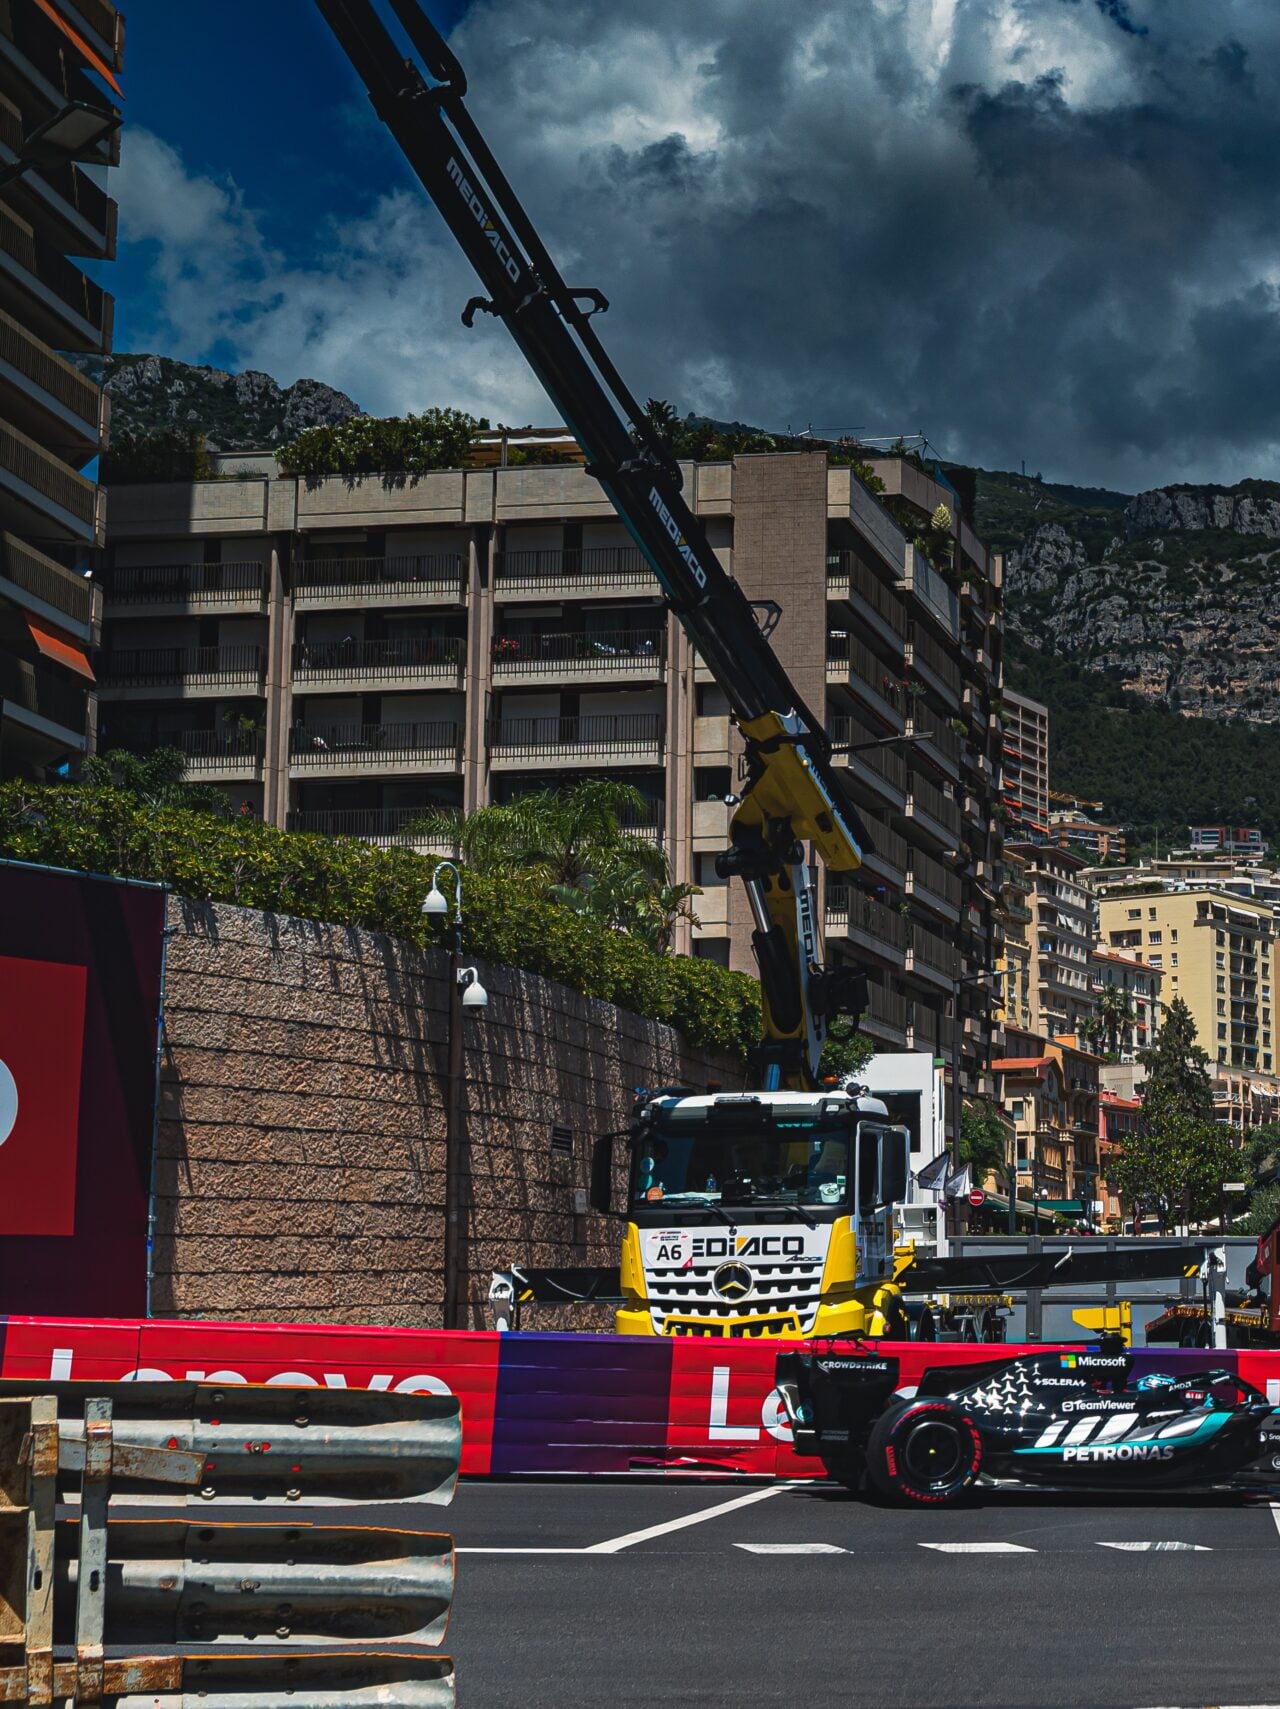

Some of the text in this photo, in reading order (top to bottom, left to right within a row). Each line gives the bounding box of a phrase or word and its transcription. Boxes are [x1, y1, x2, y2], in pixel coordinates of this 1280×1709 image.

[656, 1244, 682, 1261] A6
[692, 1236, 804, 1257] EDiACO
[822, 1361, 888, 1370] CROWDSTRIKE
[1078, 1356, 1126, 1366] Microsoft
[1074, 1401, 1136, 1411] TeamViewer
[1063, 1445, 1175, 1461] PETRONAS
